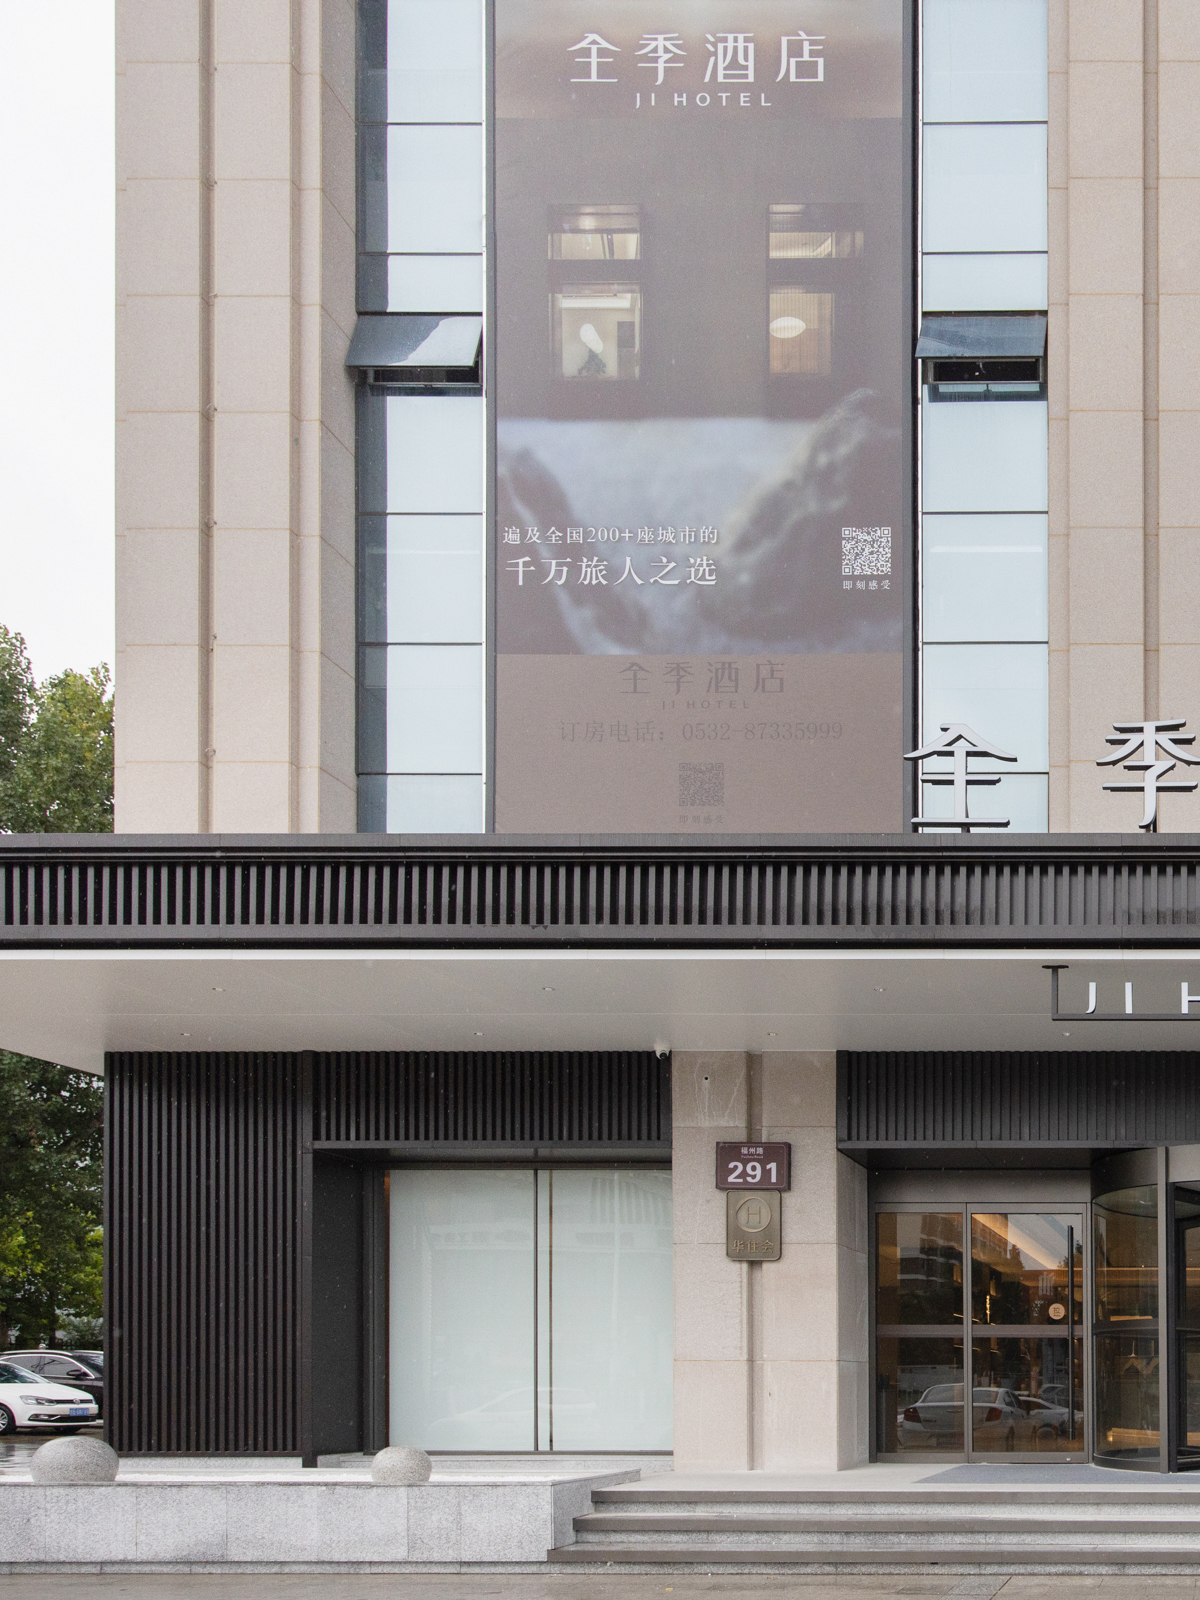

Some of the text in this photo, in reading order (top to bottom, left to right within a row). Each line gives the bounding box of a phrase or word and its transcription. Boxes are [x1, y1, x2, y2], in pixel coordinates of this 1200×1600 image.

[566, 30, 826, 86] 全季酒店
[635, 92, 772, 109] JI HOTEL
[502, 525, 718, 545] 遍及全国200+座城市的
[505, 555, 718, 586] 千万旅人之选
[842, 579, 891, 591] 即刻感受
[618, 659, 785, 696] 全季酒店
[686, 700, 750, 710] HOTEL
[1085, 981, 1133, 1014] JI
[727, 1161, 777, 1183] 291
[732, 1239, 774, 1254] 华住会
